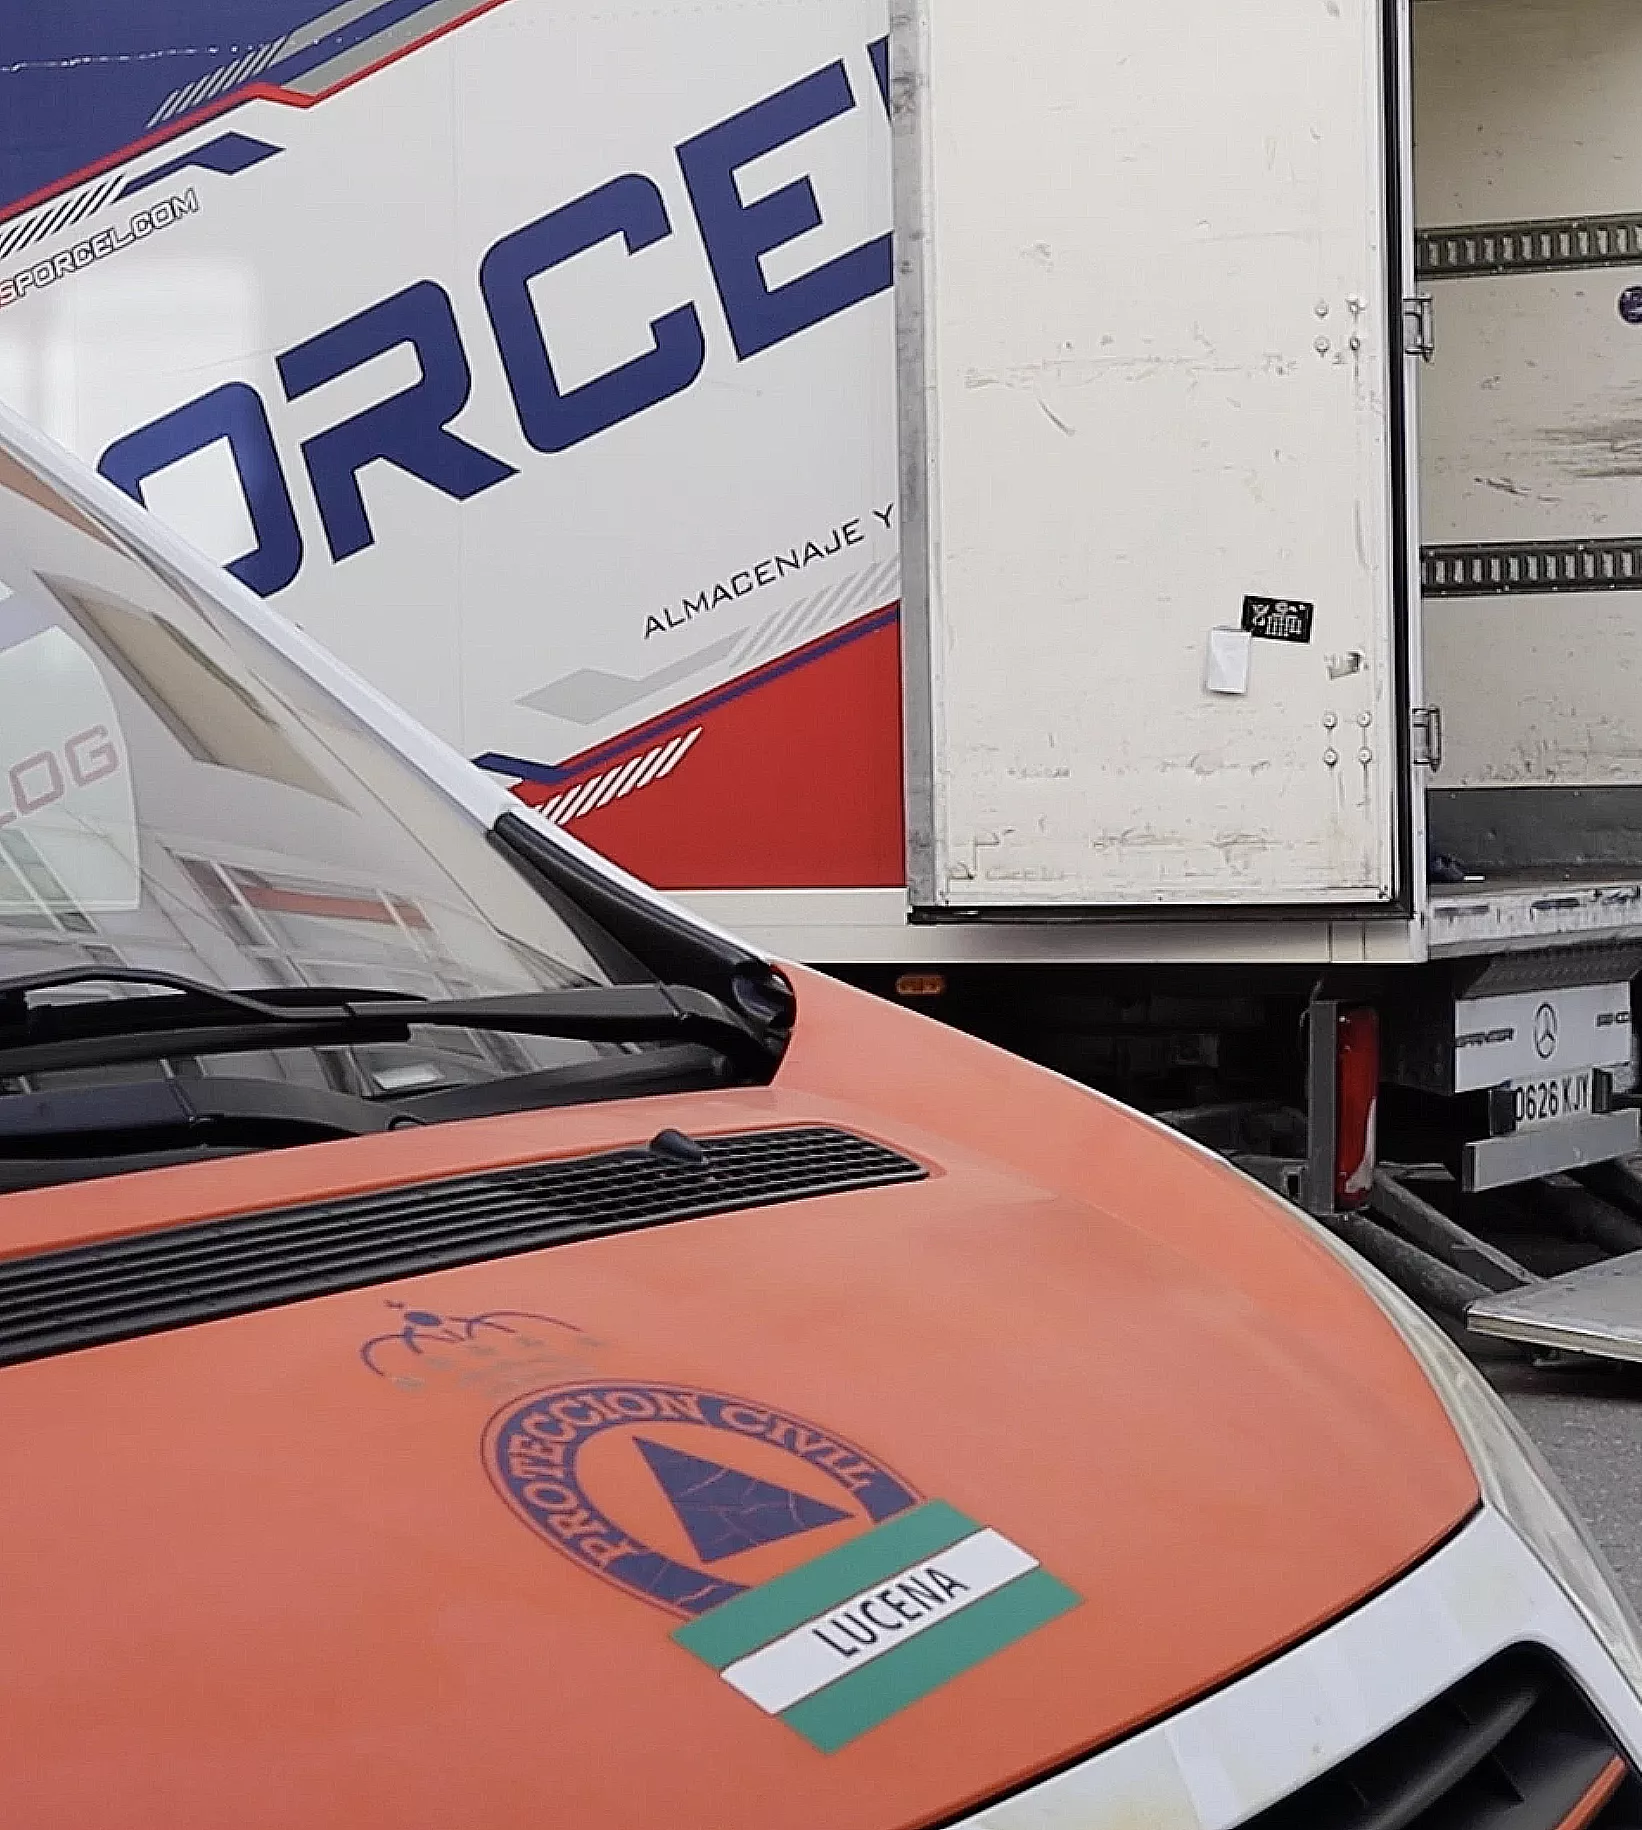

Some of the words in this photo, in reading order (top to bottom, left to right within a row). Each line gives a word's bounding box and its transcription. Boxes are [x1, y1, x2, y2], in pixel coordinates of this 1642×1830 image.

[97, 35, 895, 598] ORCE
[643, 517, 865, 639] ALMACENAJE
[873, 503, 894, 528] Y
[0, 724, 119, 828] OG
[1514, 1080, 1559, 1122] 0626
[506, 1389, 709, 1570] PROTECCION
[719, 1402, 878, 1491] CIVIL
[812, 1567, 971, 1658] LUCENA
